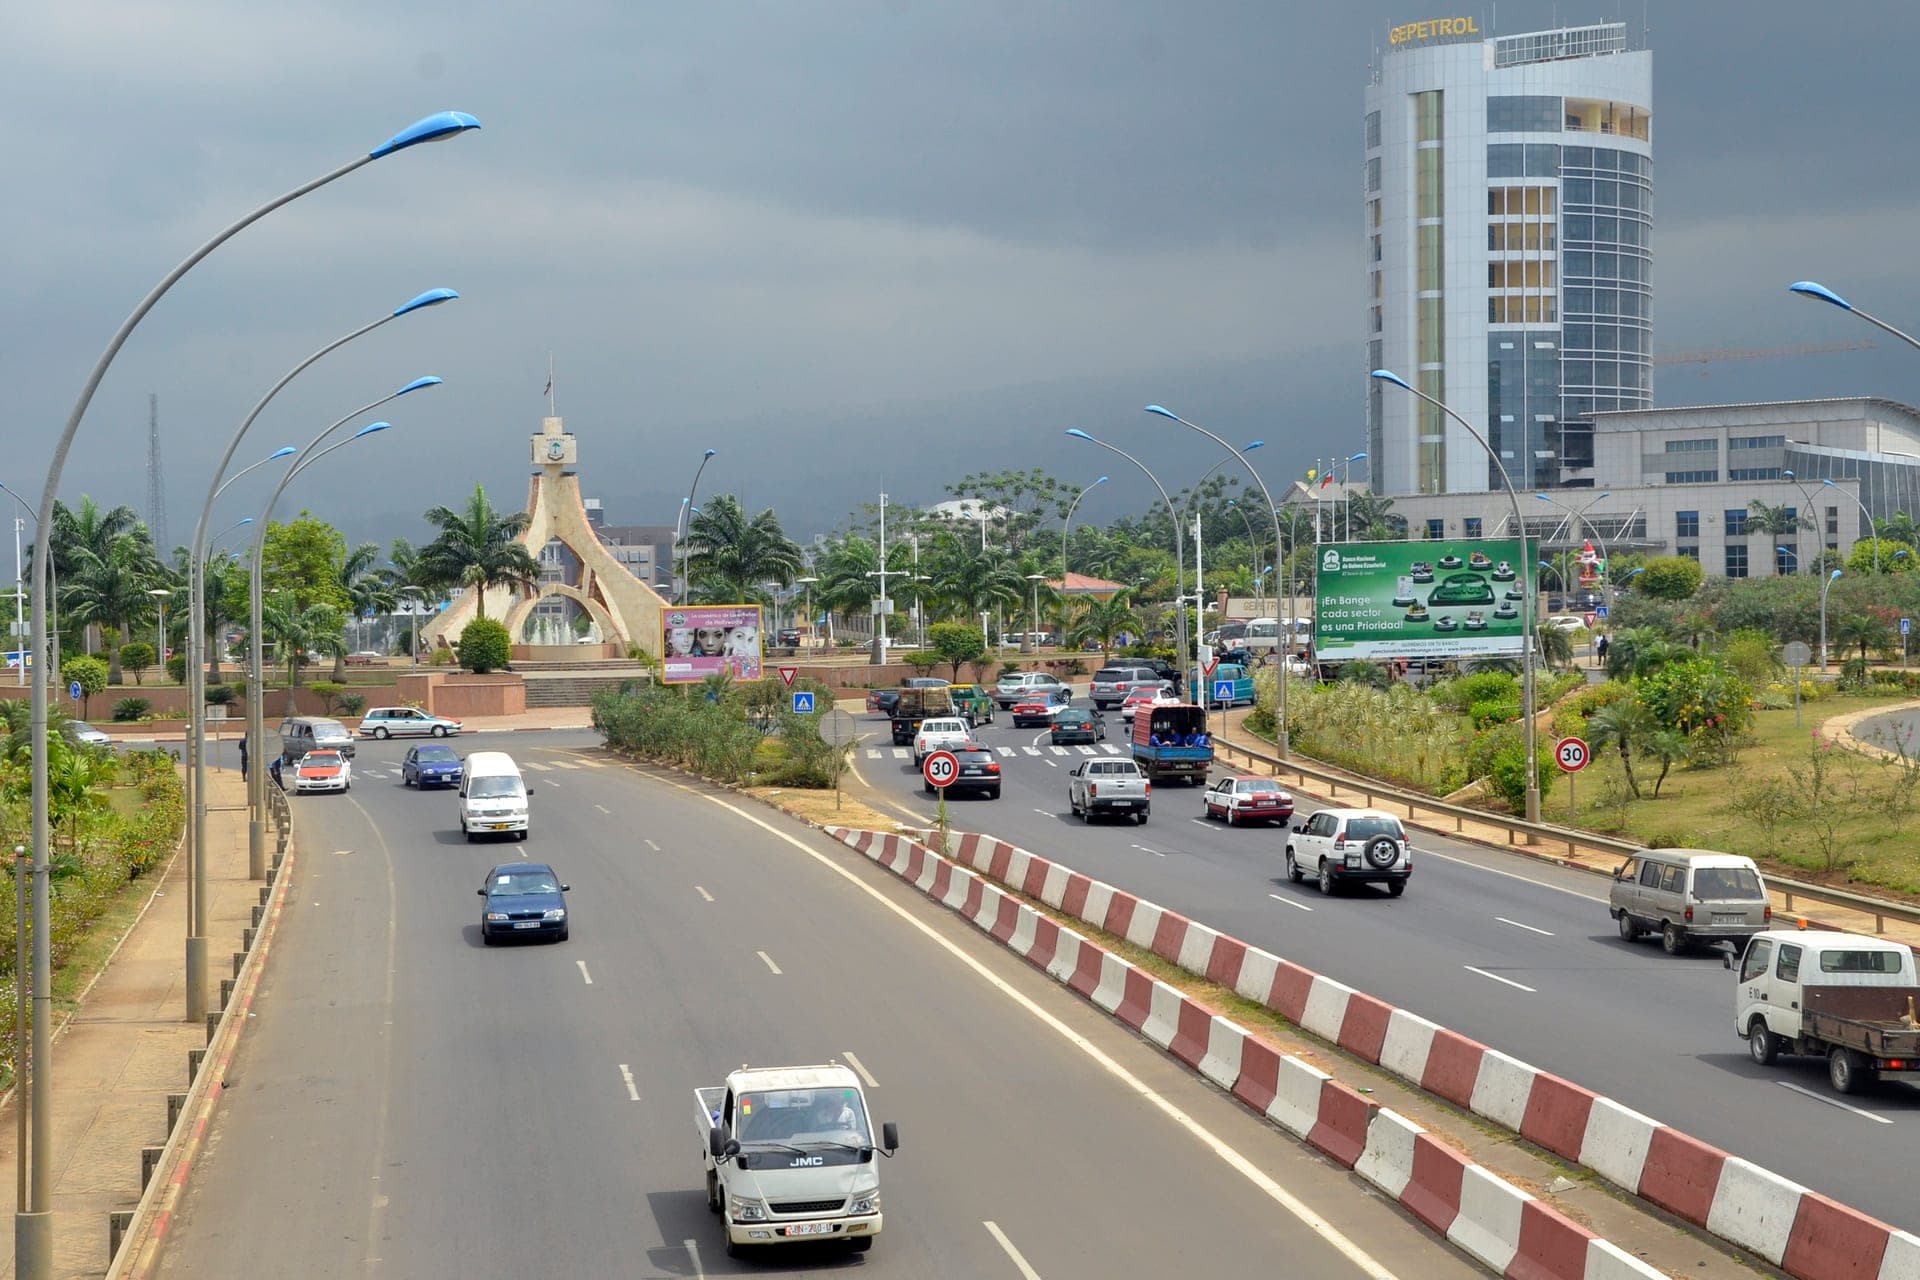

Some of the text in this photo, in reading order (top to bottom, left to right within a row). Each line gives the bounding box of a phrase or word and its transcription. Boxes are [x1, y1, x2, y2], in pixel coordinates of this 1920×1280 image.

[1390, 16, 1479, 45] GEPETROL
[1339, 596, 1370, 607] Bange
[1321, 608, 1380, 618] cada sector
[1321, 620, 1403, 631] es una Prioridad!
[1562, 747, 1582, 762] 30
[932, 761, 952, 775] 30
[790, 1156, 823, 1167] JMC
